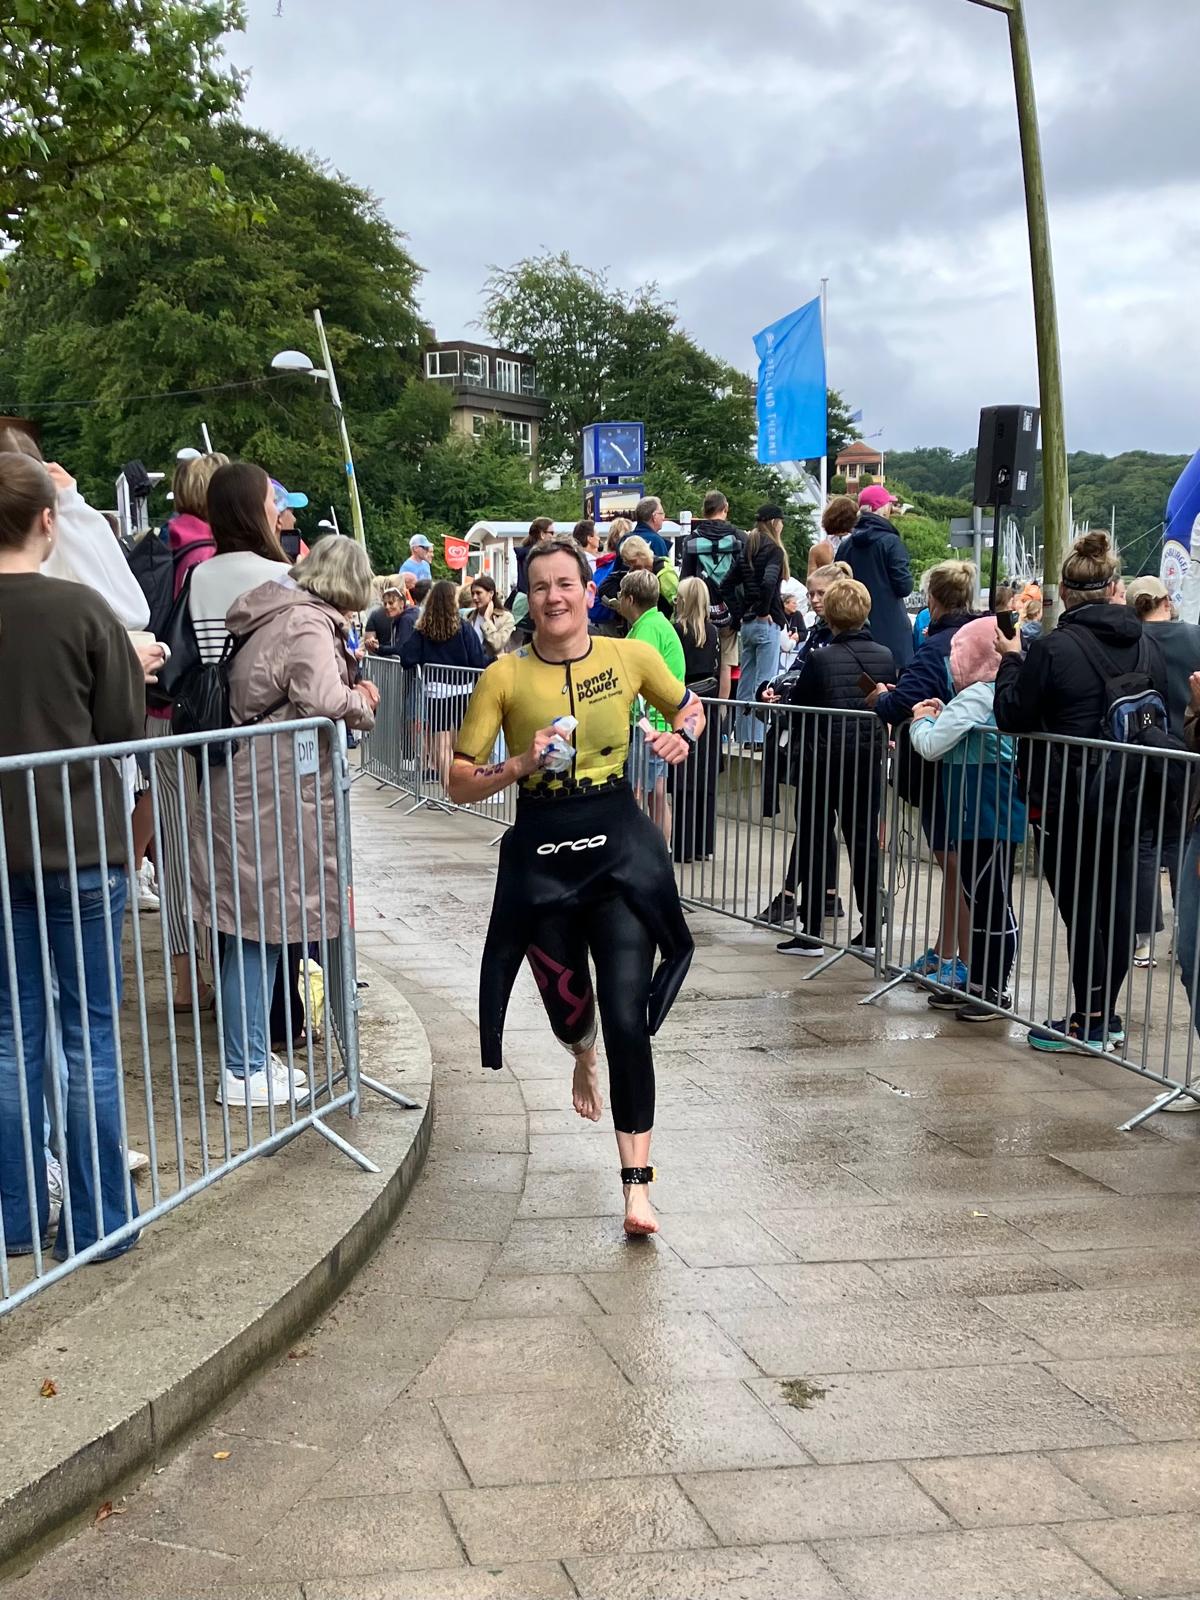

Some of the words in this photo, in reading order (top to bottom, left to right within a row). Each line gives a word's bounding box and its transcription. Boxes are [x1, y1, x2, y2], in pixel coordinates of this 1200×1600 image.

[767, 413, 777, 456] THERME
[576, 668, 613, 691] honey
[578, 677, 619, 702] power
[536, 834, 608, 855] orca
